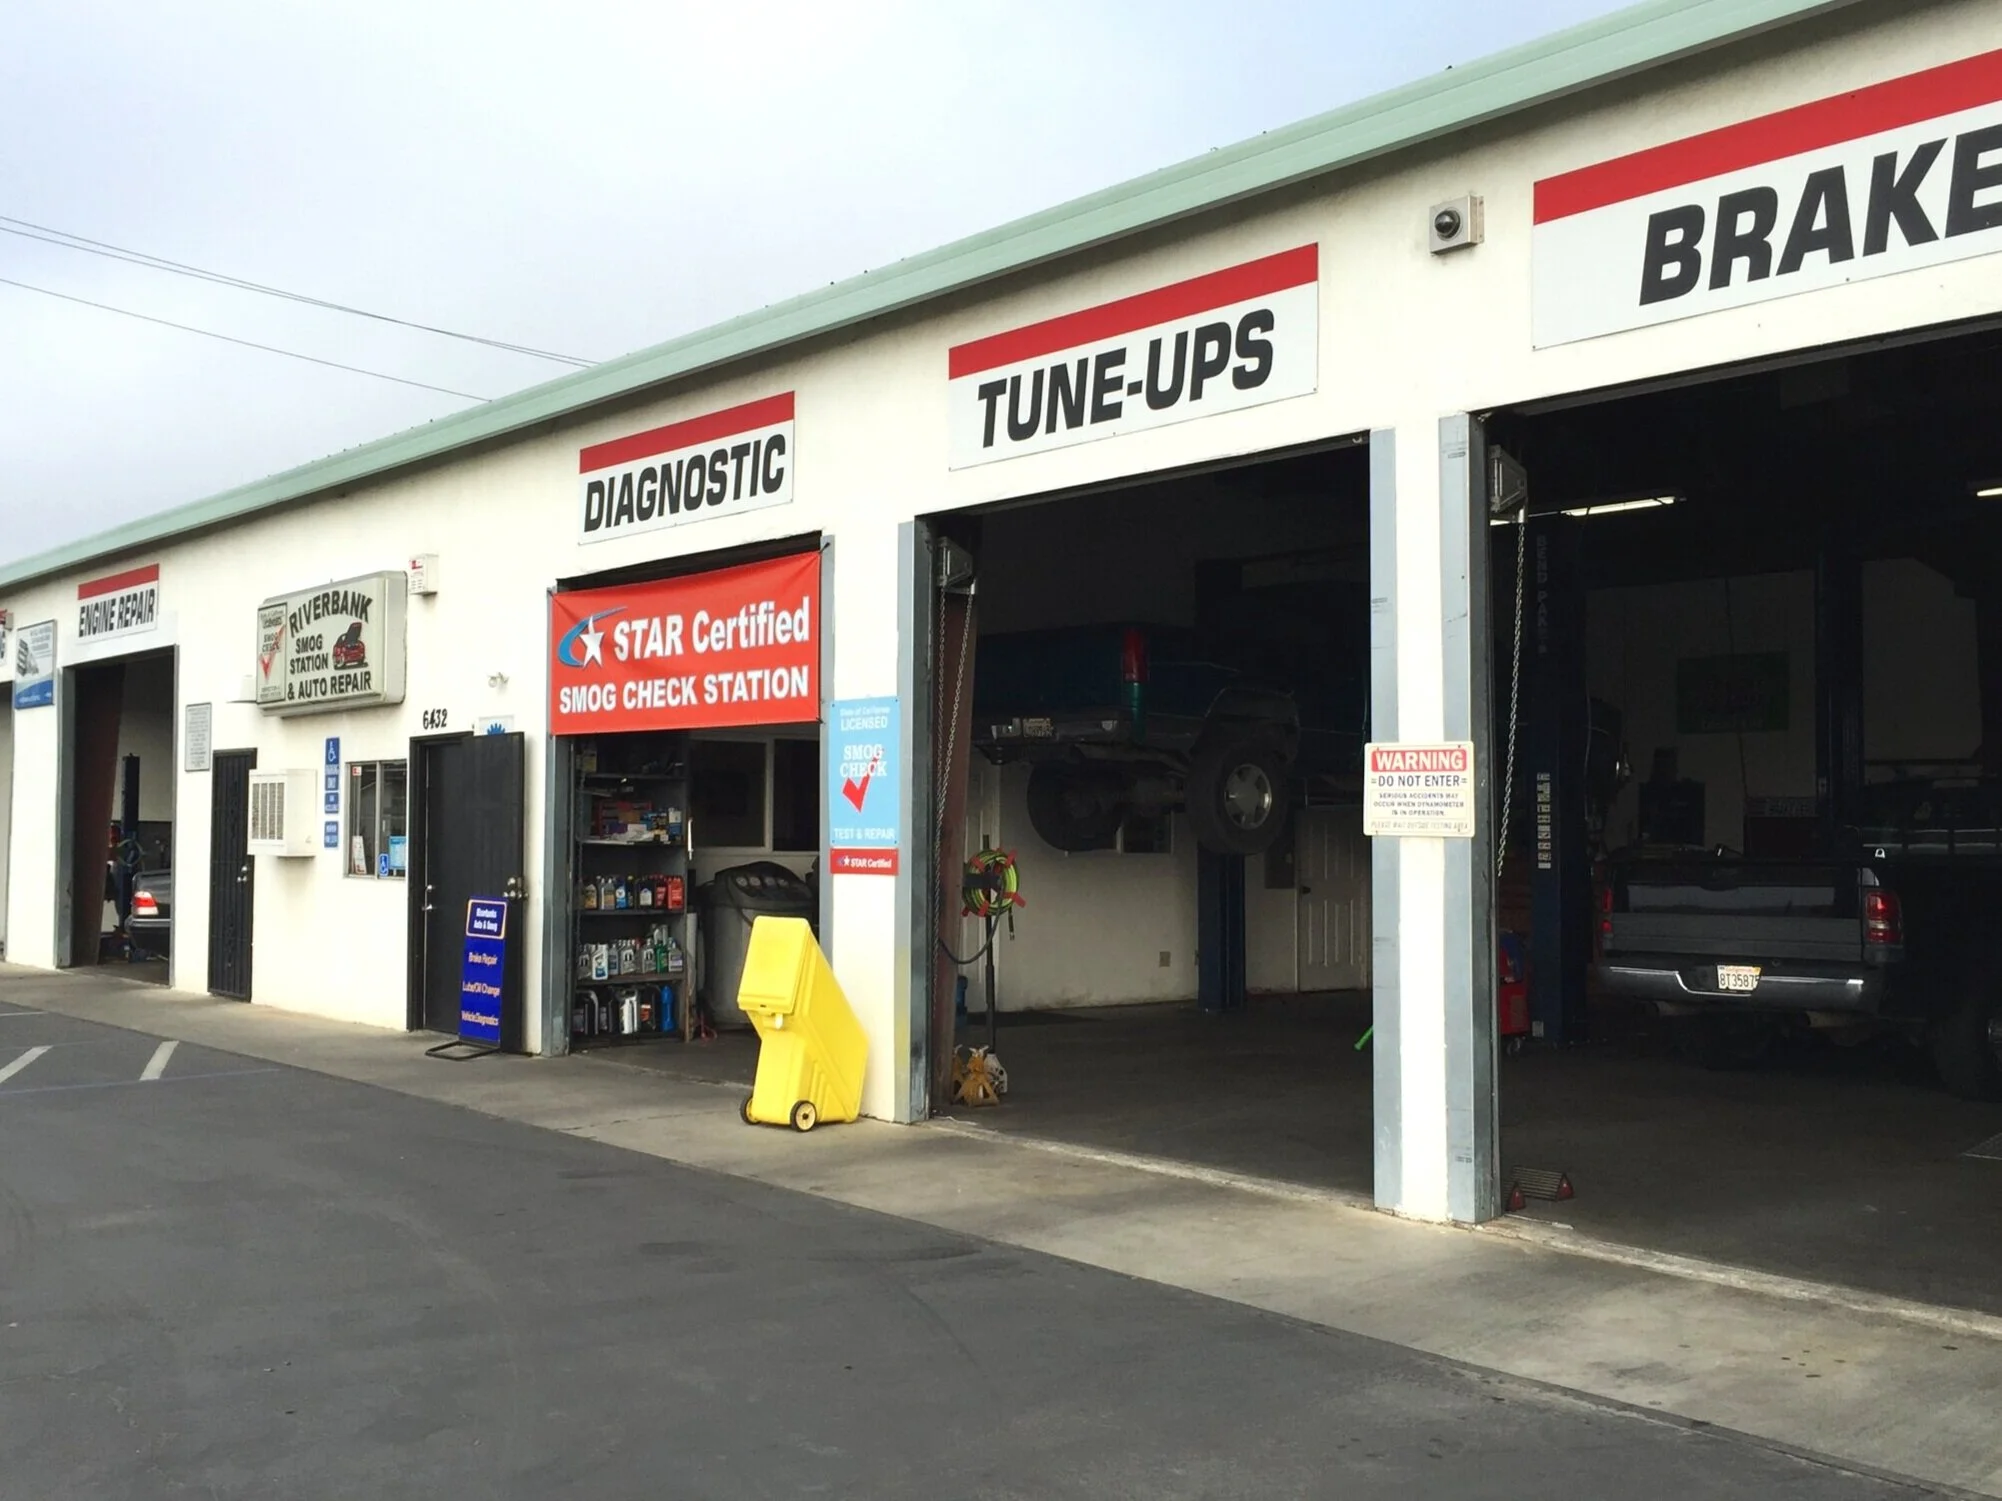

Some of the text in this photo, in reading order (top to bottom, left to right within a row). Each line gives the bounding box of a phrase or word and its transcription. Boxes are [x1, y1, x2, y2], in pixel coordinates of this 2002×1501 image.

[1639, 123, 2002, 306] BRAKE
[977, 308, 1275, 449] TUNE-UPS
[583, 433, 786, 533] DIAGNOSTIC
[78, 588, 156, 638] ENGINE REPAIR
[288, 590, 373, 638] RIVERBANK
[613, 596, 810, 662] STAR Certified
[295, 633, 323, 655] SMOG
[289, 653, 329, 675] STATION
[287, 682, 295, 700] &
[298, 677, 327, 700] AUTO
[330, 671, 372, 695] REPAIR
[559, 665, 809, 714] SMOG CHECK STATION
[422, 708, 448, 730] 6432
[840, 716, 888, 731] LICENSED
[843, 743, 883, 761] SMOG
[1375, 750, 1464, 771] WARNING
[839, 760, 888, 778] CHECK
[1378, 775, 1460, 787] DO NOT ENTER
[833, 827, 896, 840] TEST & REPAIR
[850, 858, 892, 869] STAR Certified
